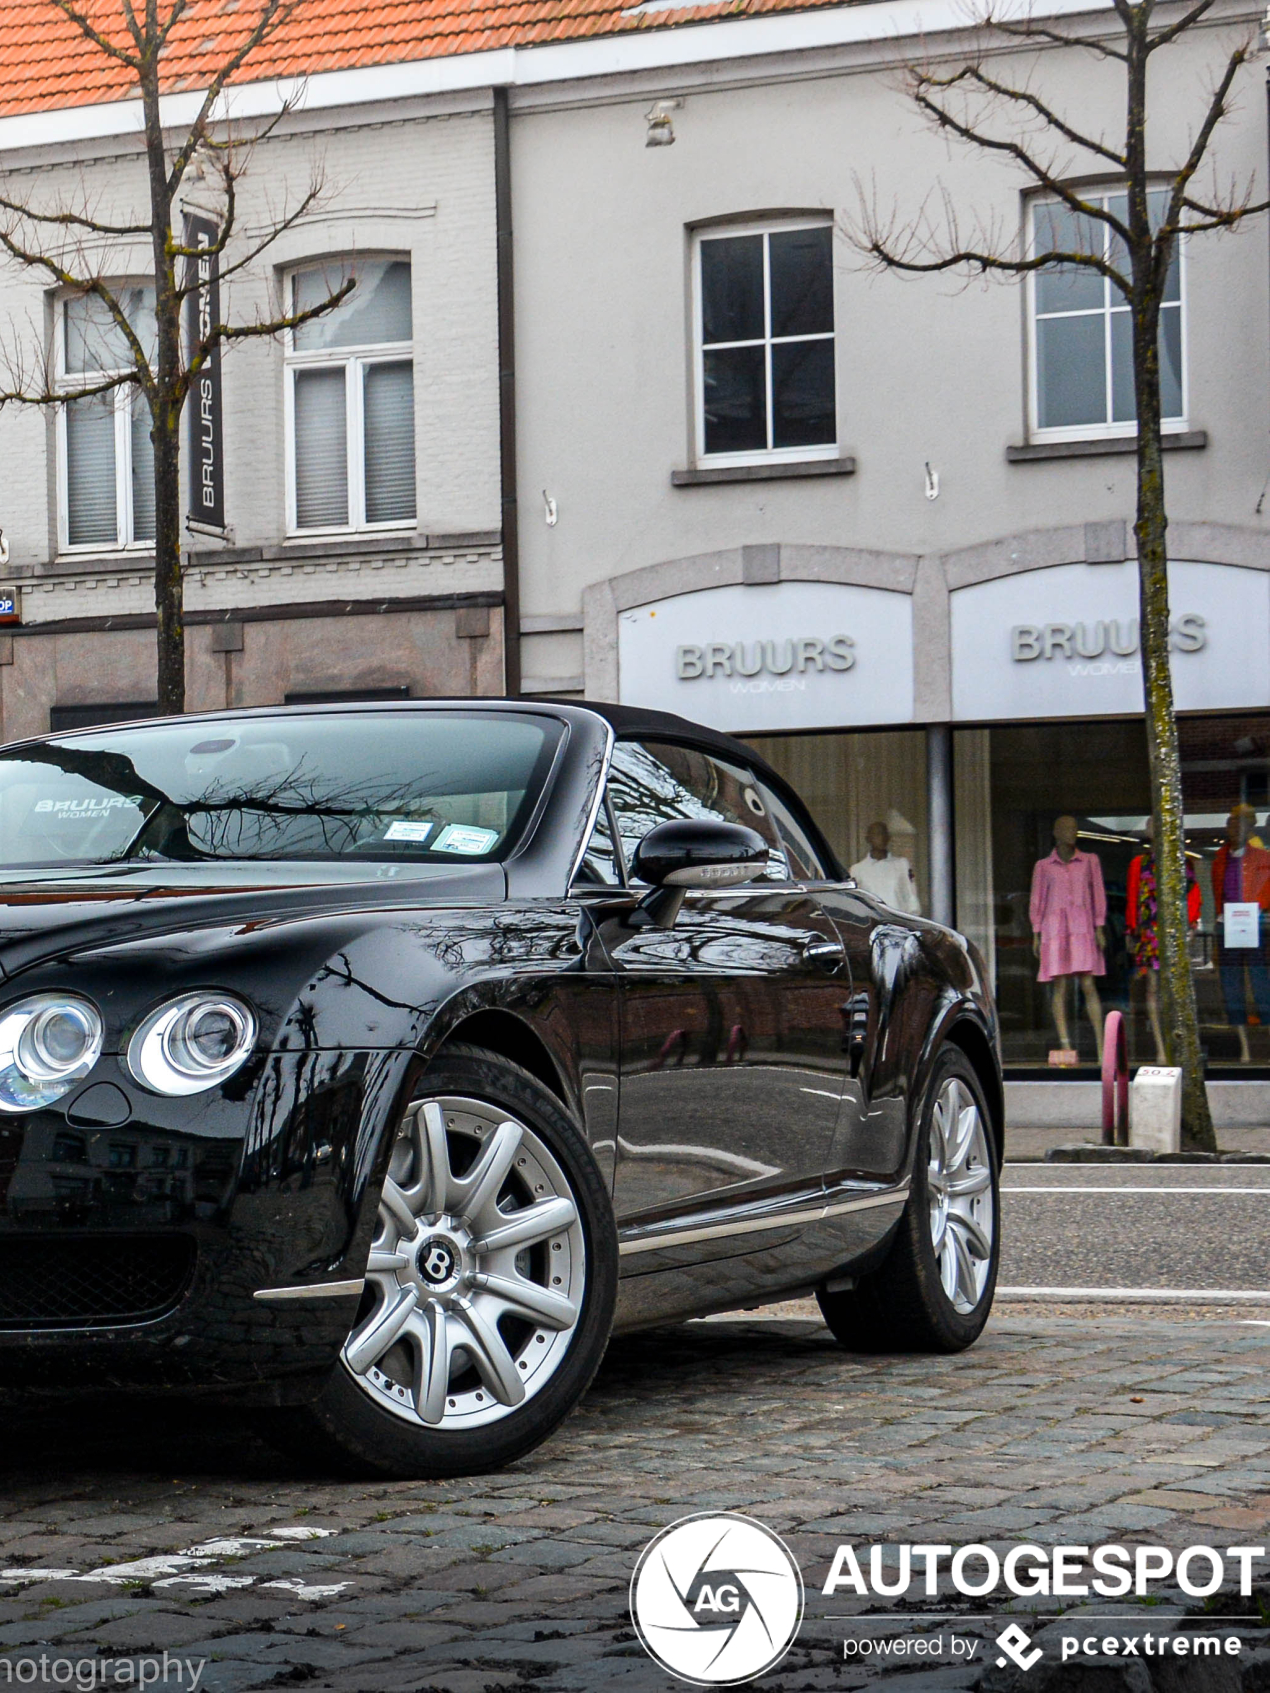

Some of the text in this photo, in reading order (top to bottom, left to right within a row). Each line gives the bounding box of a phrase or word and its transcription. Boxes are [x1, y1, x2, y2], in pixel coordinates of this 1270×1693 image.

[201, 378, 215, 508] BRUURS
[1012, 613, 1207, 662] BRUUS
[677, 635, 856, 681] BRUURS
[1067, 662, 1139, 676] WOME
[730, 679, 806, 694] WOMEN
[35, 795, 144, 812] BRUURS
[58, 809, 111, 819] WOMEN
